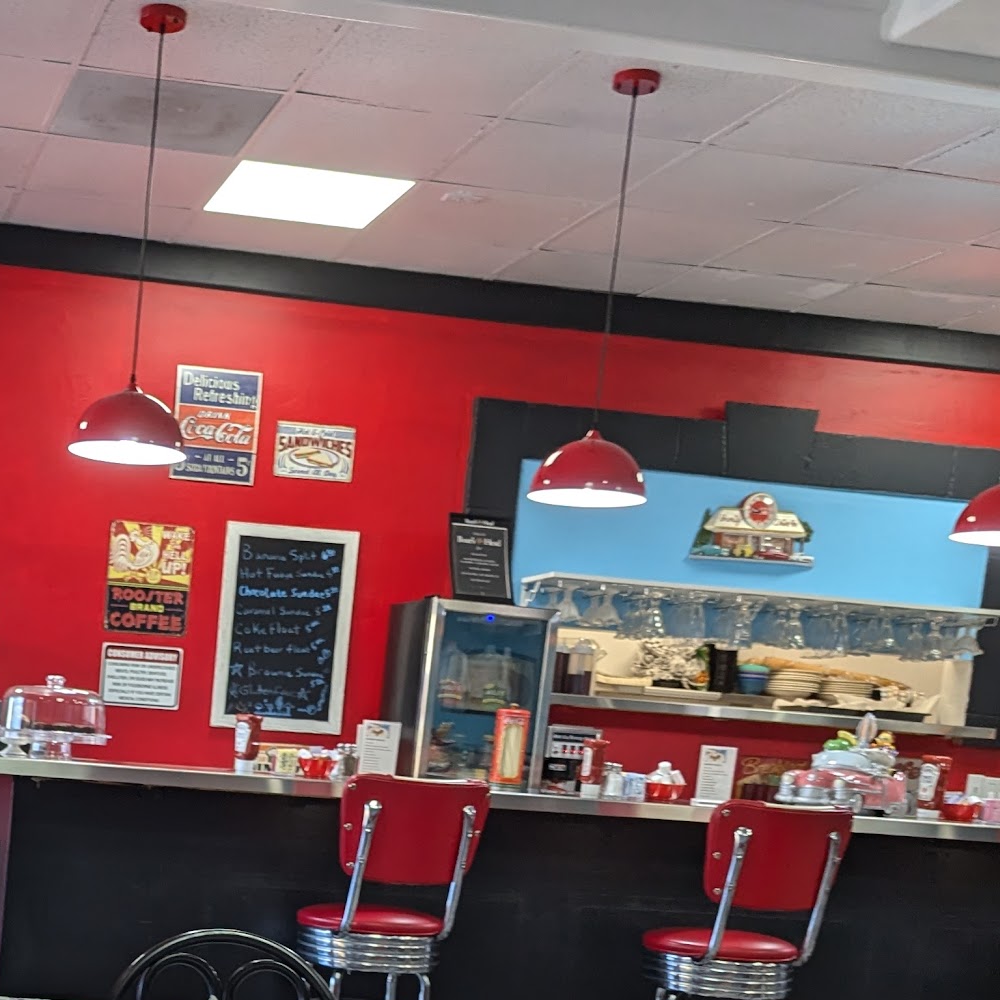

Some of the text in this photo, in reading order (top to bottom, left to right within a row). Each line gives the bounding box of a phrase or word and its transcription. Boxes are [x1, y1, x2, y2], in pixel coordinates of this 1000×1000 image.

[182, 371, 240, 391] Delicious
[192, 387, 258, 410] Refreshing
[278, 436, 353, 458] SANDWICHES
[161, 562, 188, 575] UP!
[111, 587, 184, 605] ROOSTER
[238, 585, 288, 599] Chocolate
[128, 602, 165, 613] BRAND
[109, 611, 182, 632] COFFEE
